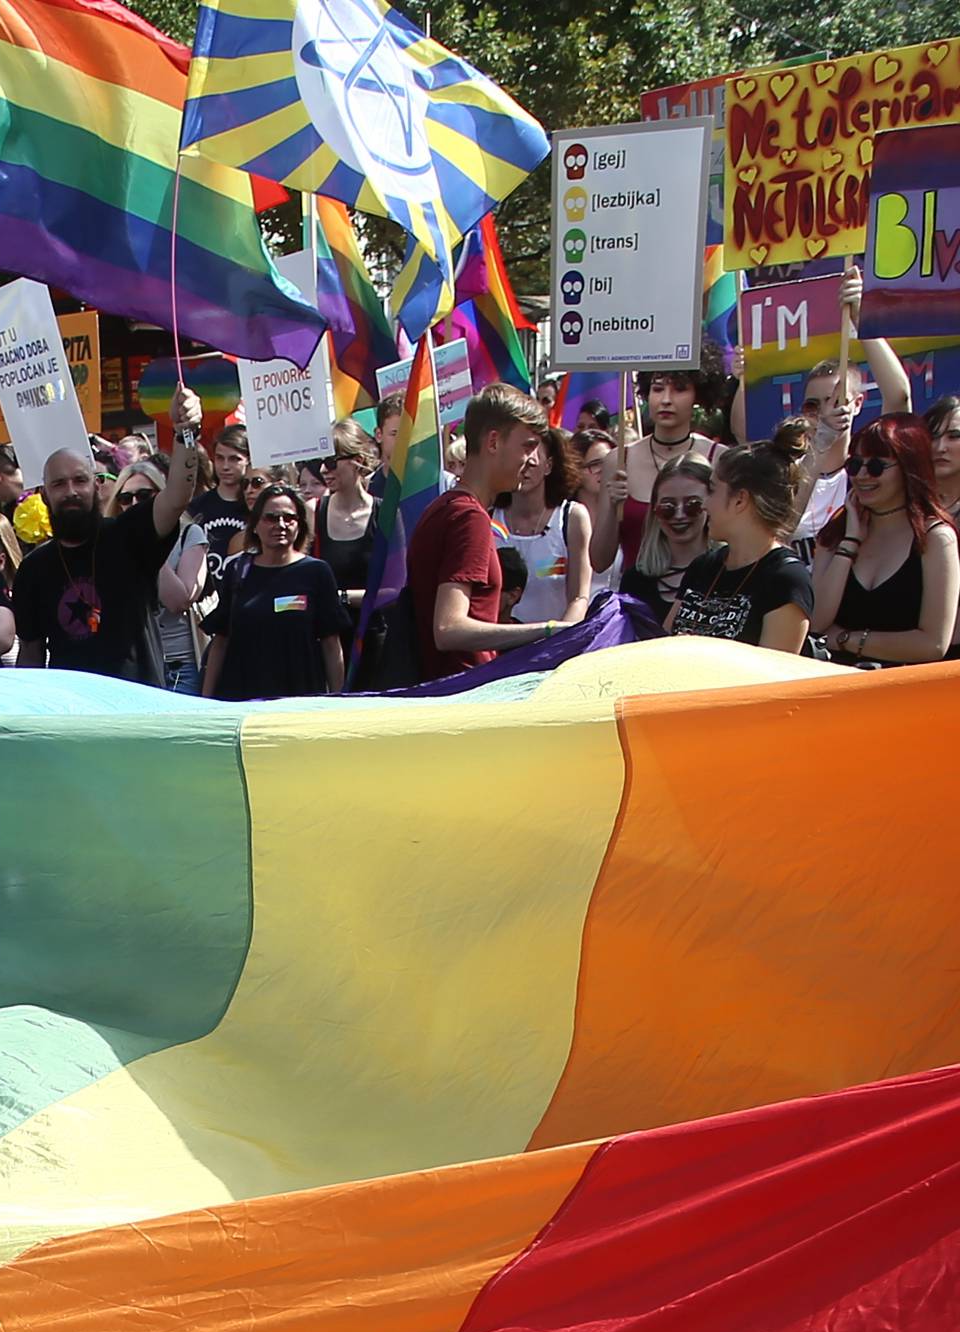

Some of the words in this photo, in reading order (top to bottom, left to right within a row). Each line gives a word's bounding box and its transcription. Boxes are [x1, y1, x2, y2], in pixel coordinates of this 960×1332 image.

[728, 99, 781, 168] Ne
[592, 149, 626, 170] [gej]
[591, 188, 661, 212] [lezbijka]
[590, 232, 639, 254] [trans]
[589, 276, 613, 295] [bi]
[588, 314, 655, 335] [nebitno]
[750, 296, 809, 350] I'M
[8, 327, 17, 343] U
[26, 337, 50, 359] DOBA
[47, 356, 60, 375] JE
[256, 386, 312, 420] PONOS
